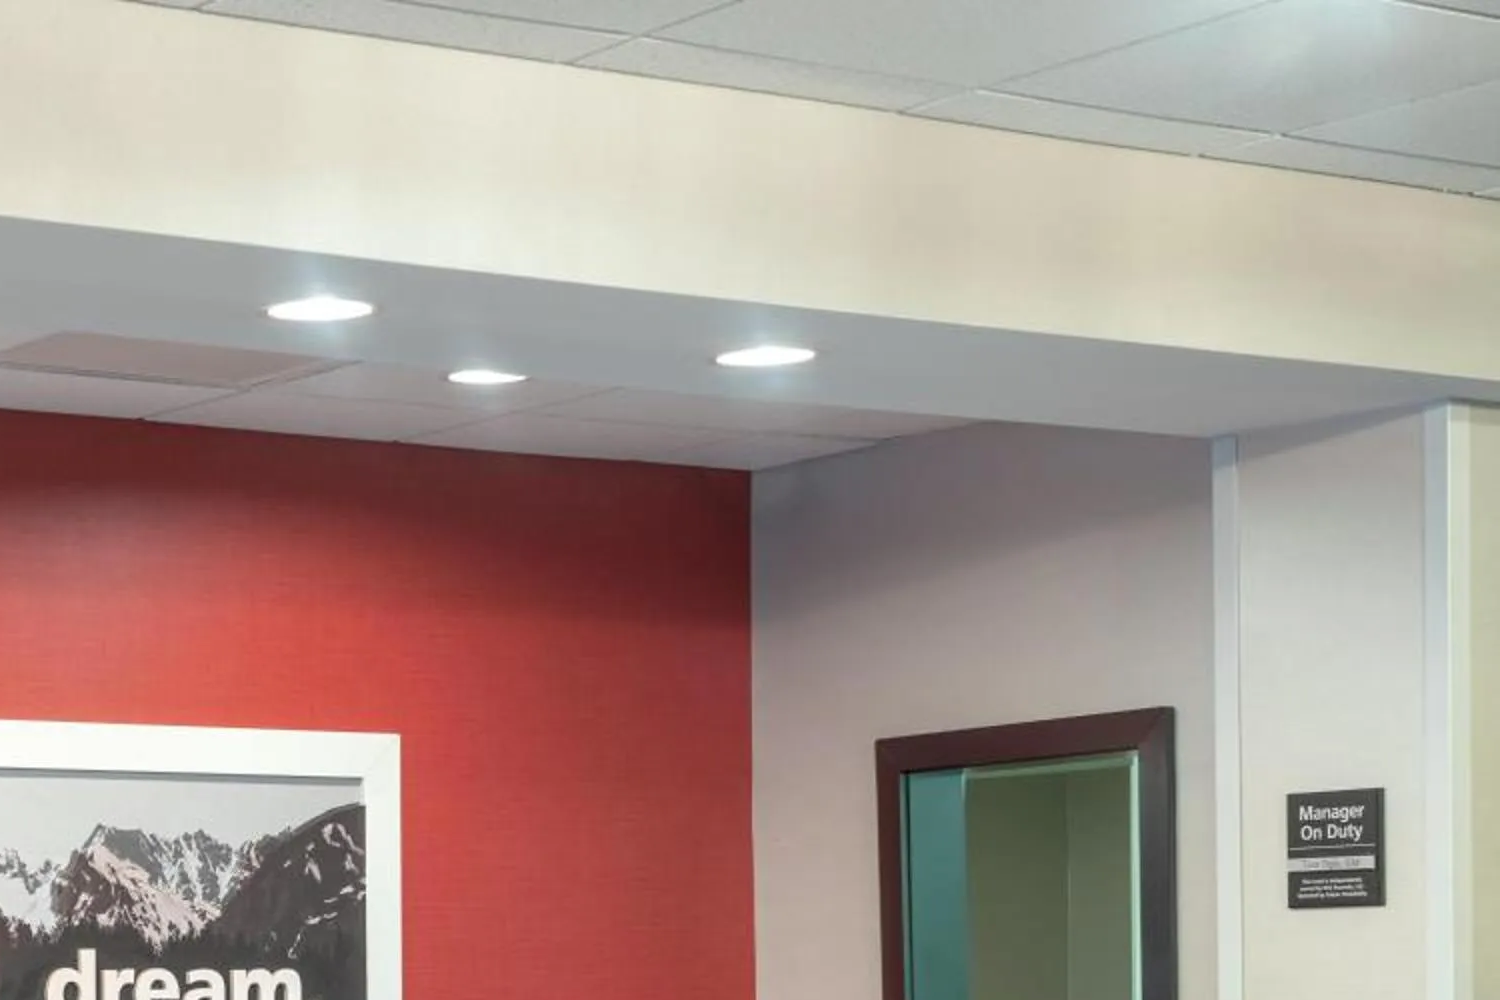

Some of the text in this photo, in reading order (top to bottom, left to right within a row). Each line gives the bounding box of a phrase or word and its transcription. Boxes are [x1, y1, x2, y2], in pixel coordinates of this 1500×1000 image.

[1299, 805, 1365, 823] Manager
[1300, 823, 1363, 842] On Duty
